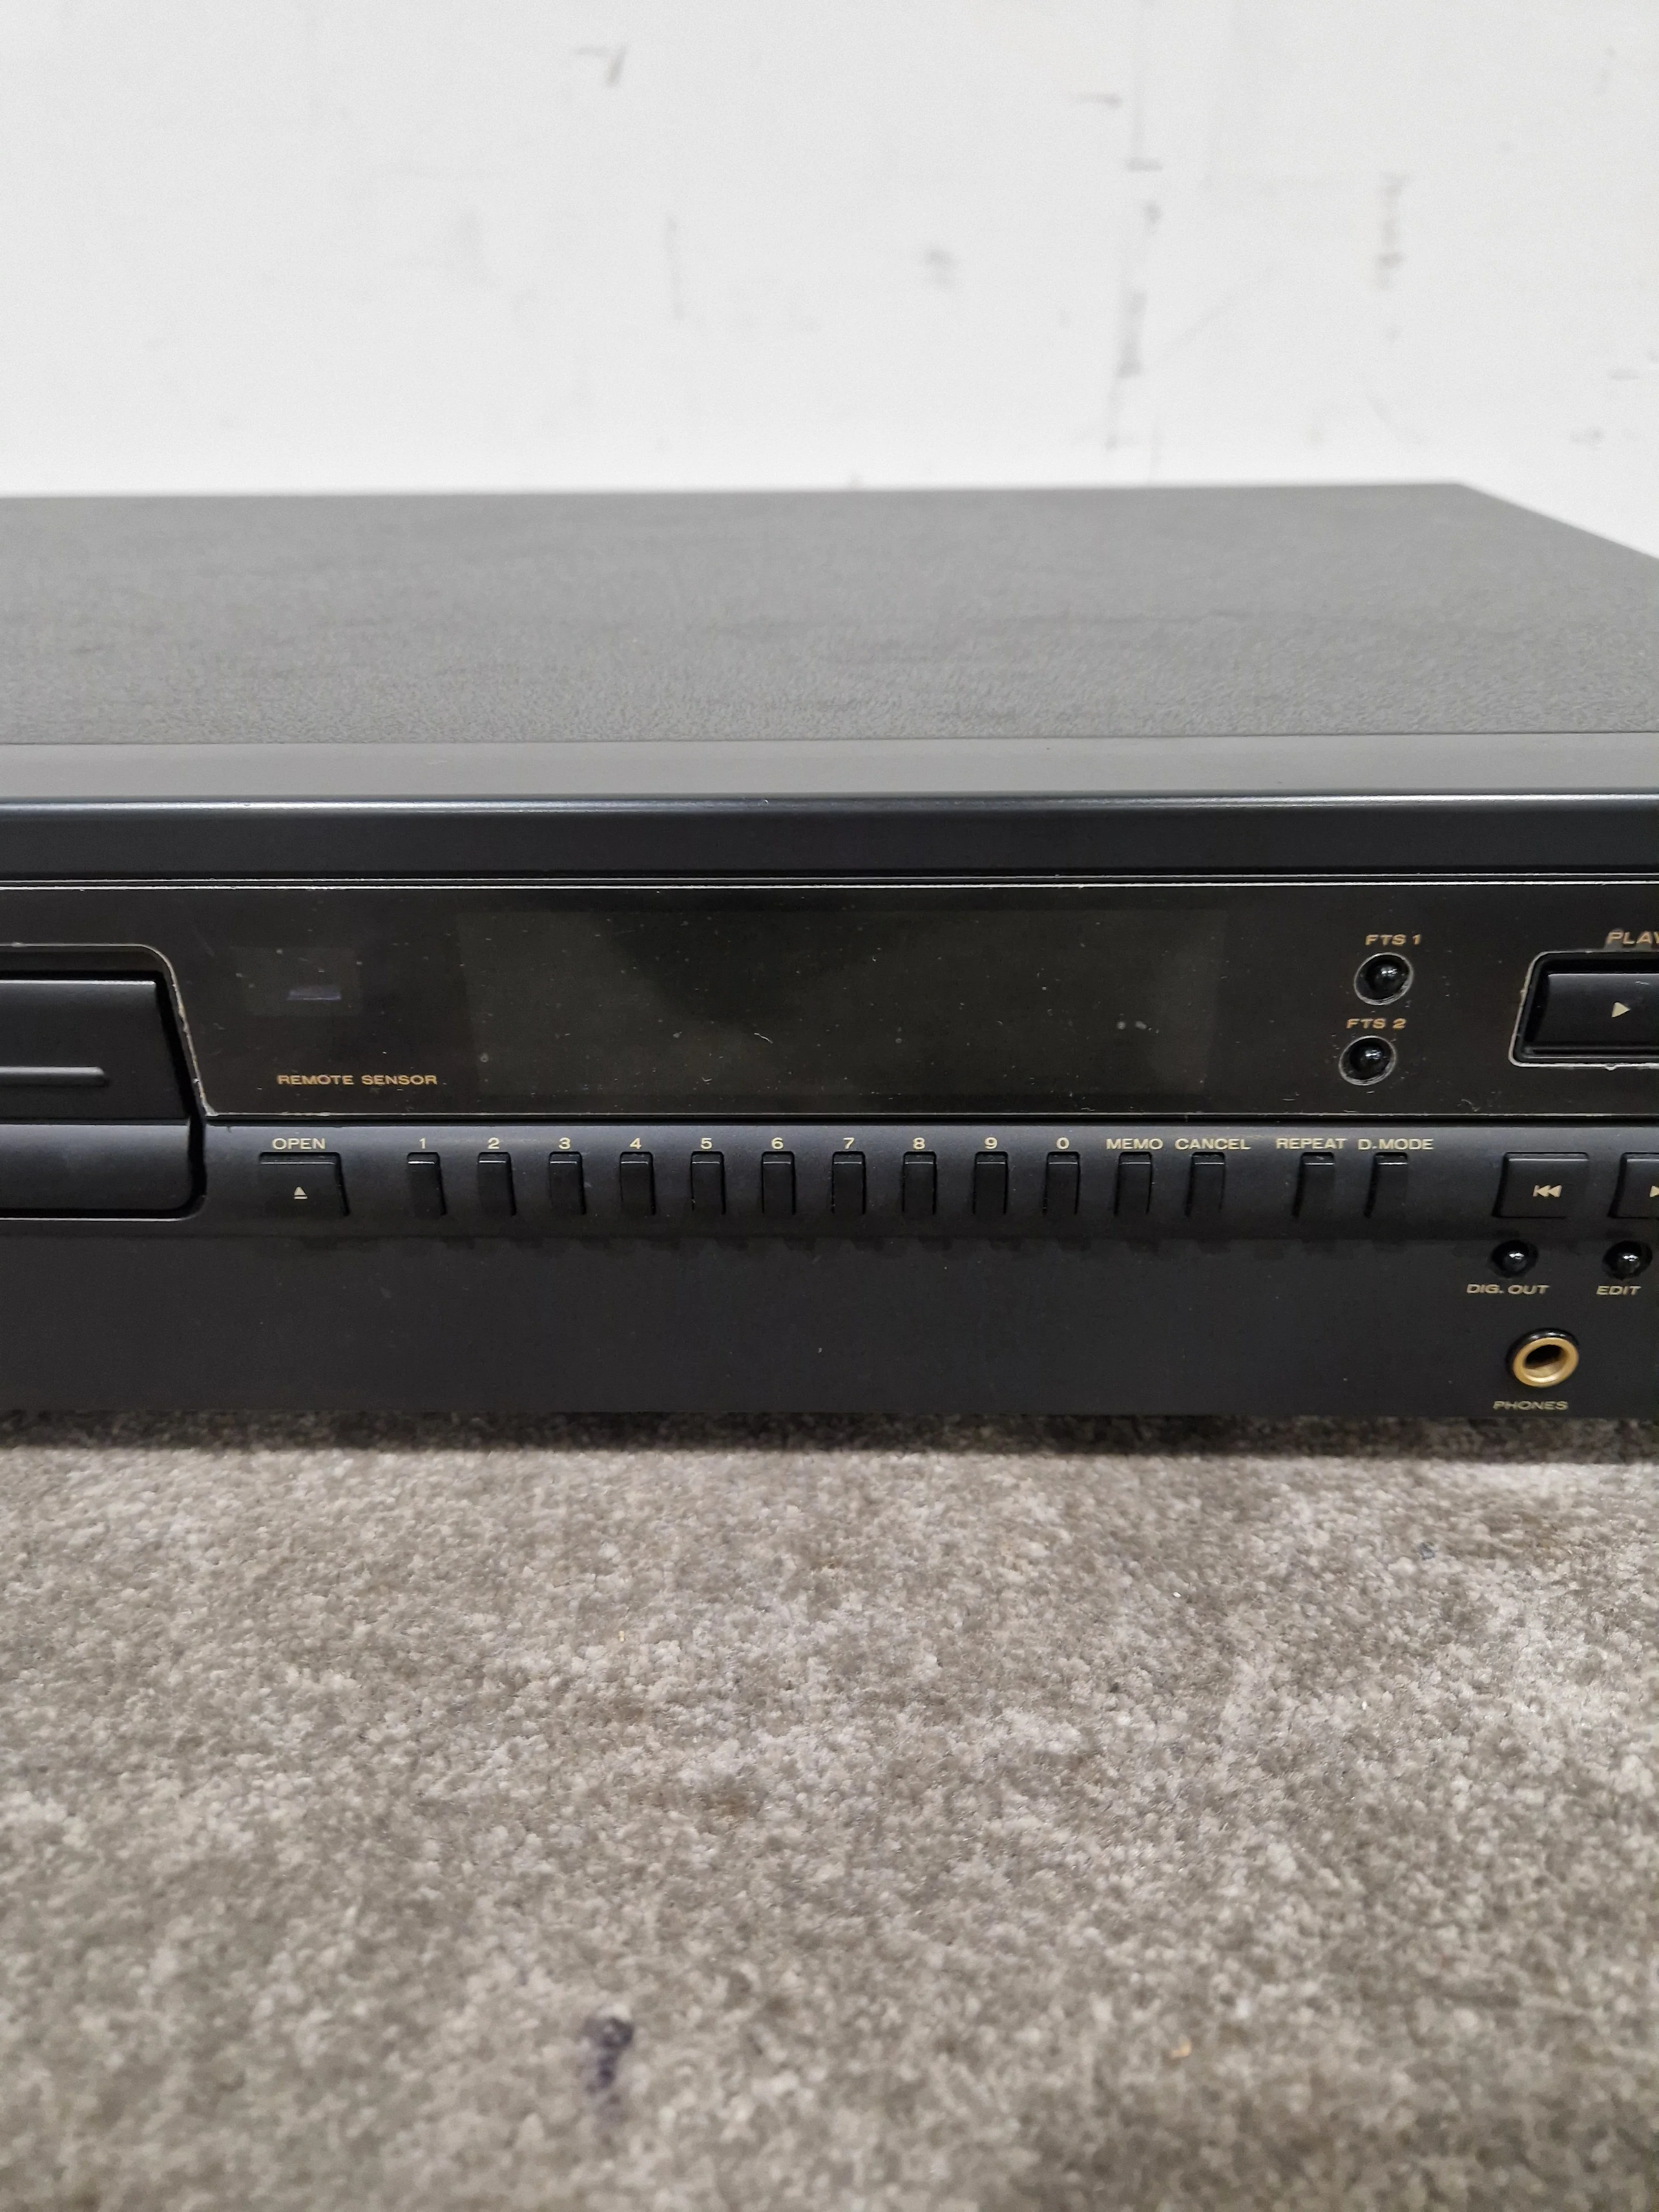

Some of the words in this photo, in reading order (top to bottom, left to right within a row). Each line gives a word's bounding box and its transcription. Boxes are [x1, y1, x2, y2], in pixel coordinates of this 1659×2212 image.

[1365, 934, 1407, 946] FTS
[1412, 934, 1422, 945] 1
[1347, 1019, 1387, 1029] FTS
[1392, 1019, 1406, 1029] 2
[278, 1074, 354, 1086] REMOTE
[361, 1074, 438, 1086] SENSOR
[272, 1138, 326, 1150] OPEN
[420, 1138, 426, 1150] 1
[487, 1138, 499, 1150] 2
[559, 1138, 571, 1150] 3
[629, 1138, 641, 1149] 4
[700, 1138, 712, 1150] 5
[771, 1138, 784, 1149] 6
[843, 1138, 854, 1149] 7
[912, 1138, 925, 1150] 8
[984, 1137, 998, 1150] 9
[1107, 1138, 1164, 1150] MEMO
[1175, 1138, 1251, 1150] CANCEL
[1276, 1138, 1348, 1150] REPEAT
[1358, 1138, 1434, 1150] D.MODE
[1467, 1284, 1504, 1295] DIG.
[1507, 1284, 1549, 1295] OUT
[1596, 1285, 1640, 1295] EDIT
[1493, 1401, 1568, 1410] PHONES
